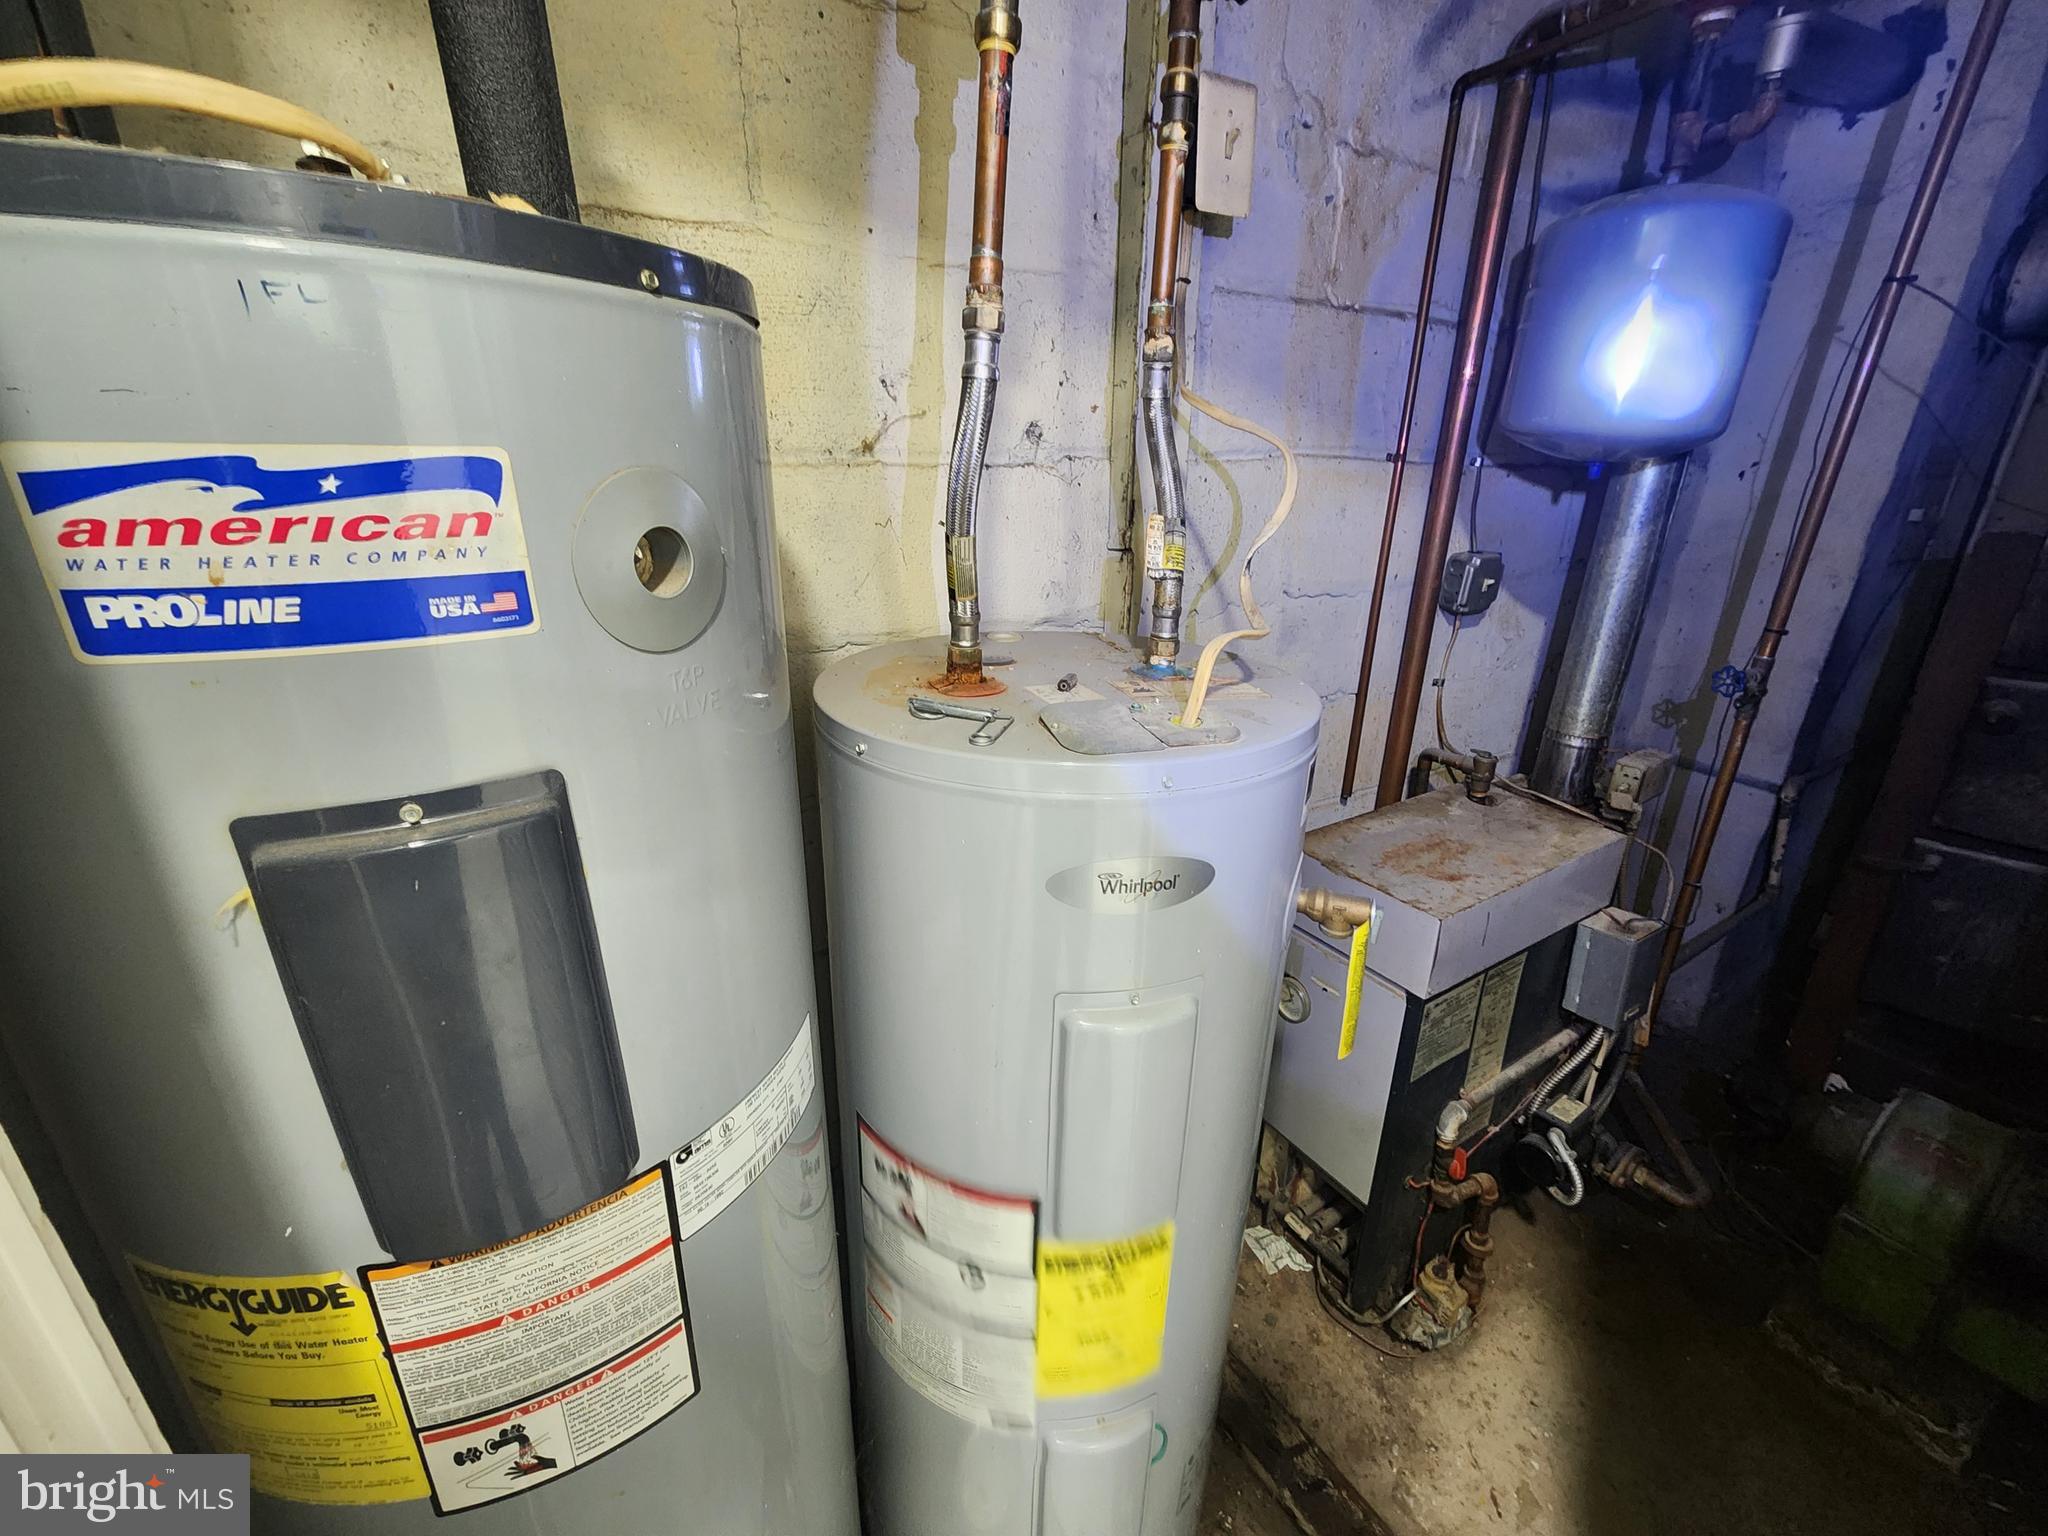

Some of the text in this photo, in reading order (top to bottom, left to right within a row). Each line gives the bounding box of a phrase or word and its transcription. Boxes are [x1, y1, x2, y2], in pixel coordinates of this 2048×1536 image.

[57, 511, 493, 549] american
[65, 545, 488, 572] WATER HEATER COMPANY
[83, 594, 301, 629] PROLINE
[428, 594, 477, 605] MADE IN
[430, 603, 481, 618] USA
[657, 688, 721, 728] VALVE
[1100, 875, 1177, 897] Whirlpool
[536, 1190, 628, 1237] ADVERTENCIA
[514, 1262, 554, 1281] CAUTION
[473, 1260, 600, 1313] STATE OF CALIFORNIA NOTICE
[523, 1283, 591, 1317] DANGER
[521, 1310, 572, 1335] IMPORTANT
[238, 1340, 256, 1348] Use
[296, 1340, 328, 1349] Water
[332, 1336, 369, 1347] Heater
[242, 1350, 275, 1360] Before
[277, 1351, 297, 1360] You
[529, 1378, 594, 1412] DANGER
